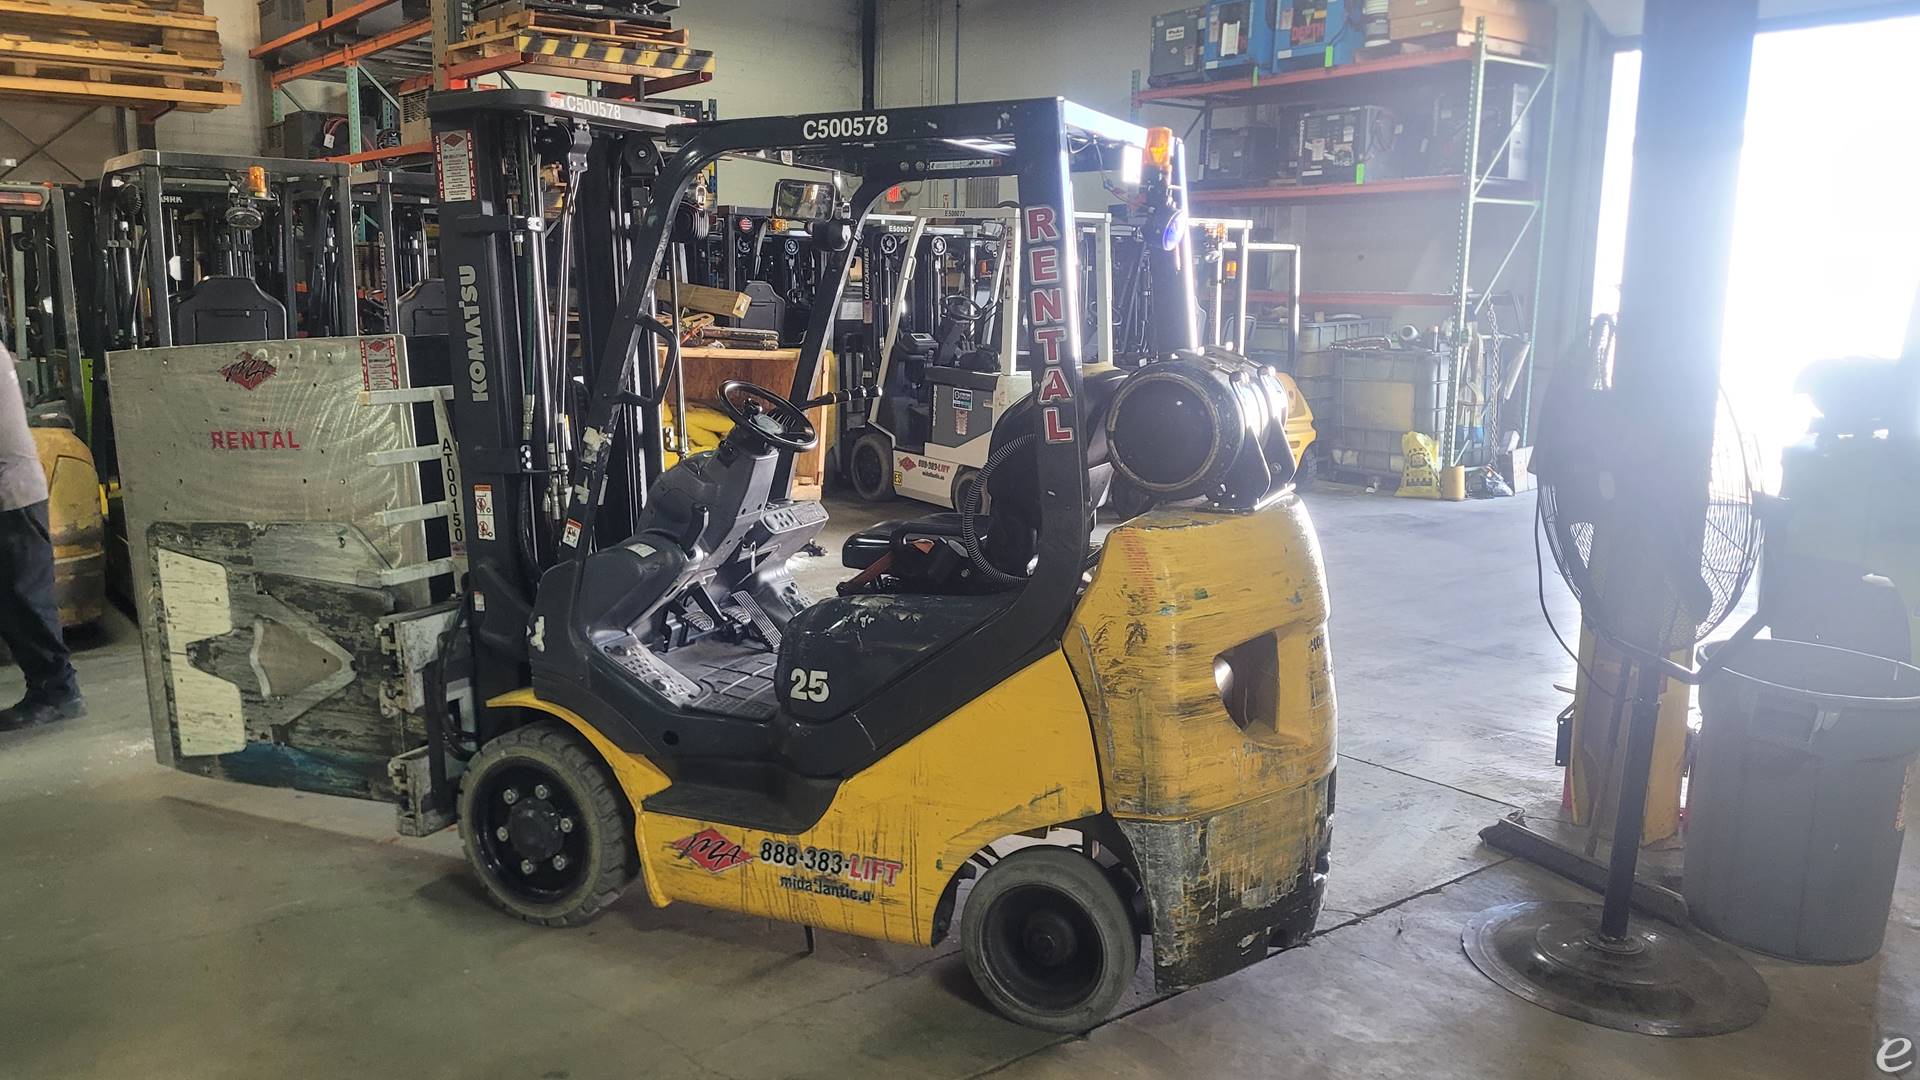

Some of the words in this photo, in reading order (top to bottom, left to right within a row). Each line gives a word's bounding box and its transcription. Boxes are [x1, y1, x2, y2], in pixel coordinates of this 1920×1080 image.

[566, 95, 621, 120] C500578
[803, 115, 889, 140] C500578
[435, 135, 444, 199] SERVICE
[1003, 225, 1013, 299] RENTAL
[458, 265, 489, 402] KOMATSU
[1024, 206, 1074, 443] RENTAL
[210, 430, 301, 450] RENTAL
[442, 438, 464, 542] AT00150
[790, 667, 830, 703] 25
